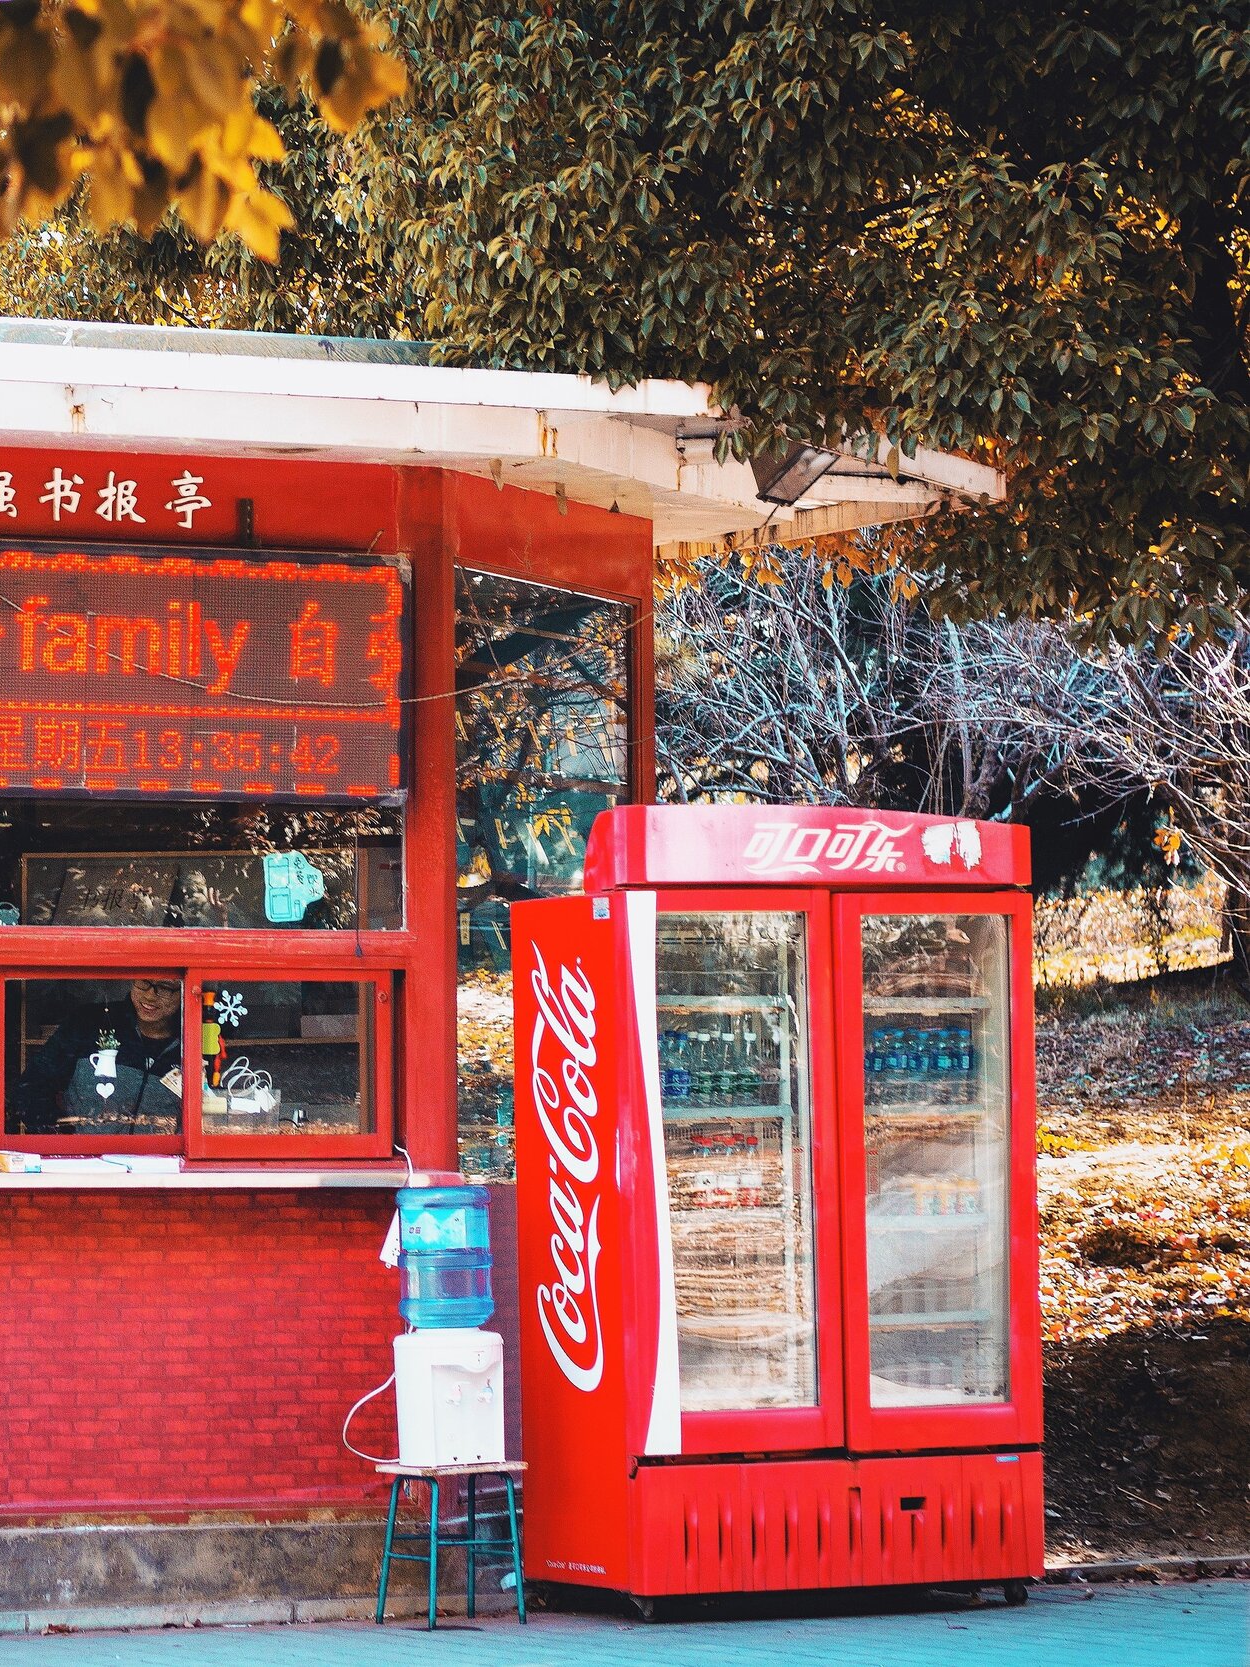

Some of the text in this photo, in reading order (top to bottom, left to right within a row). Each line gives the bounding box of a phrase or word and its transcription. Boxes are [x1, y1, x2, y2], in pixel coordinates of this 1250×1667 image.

[16, 595, 250, 695] family
[743, 821, 914, 873] 可口可乐
[530, 939, 603, 1392] Coca-Cola
